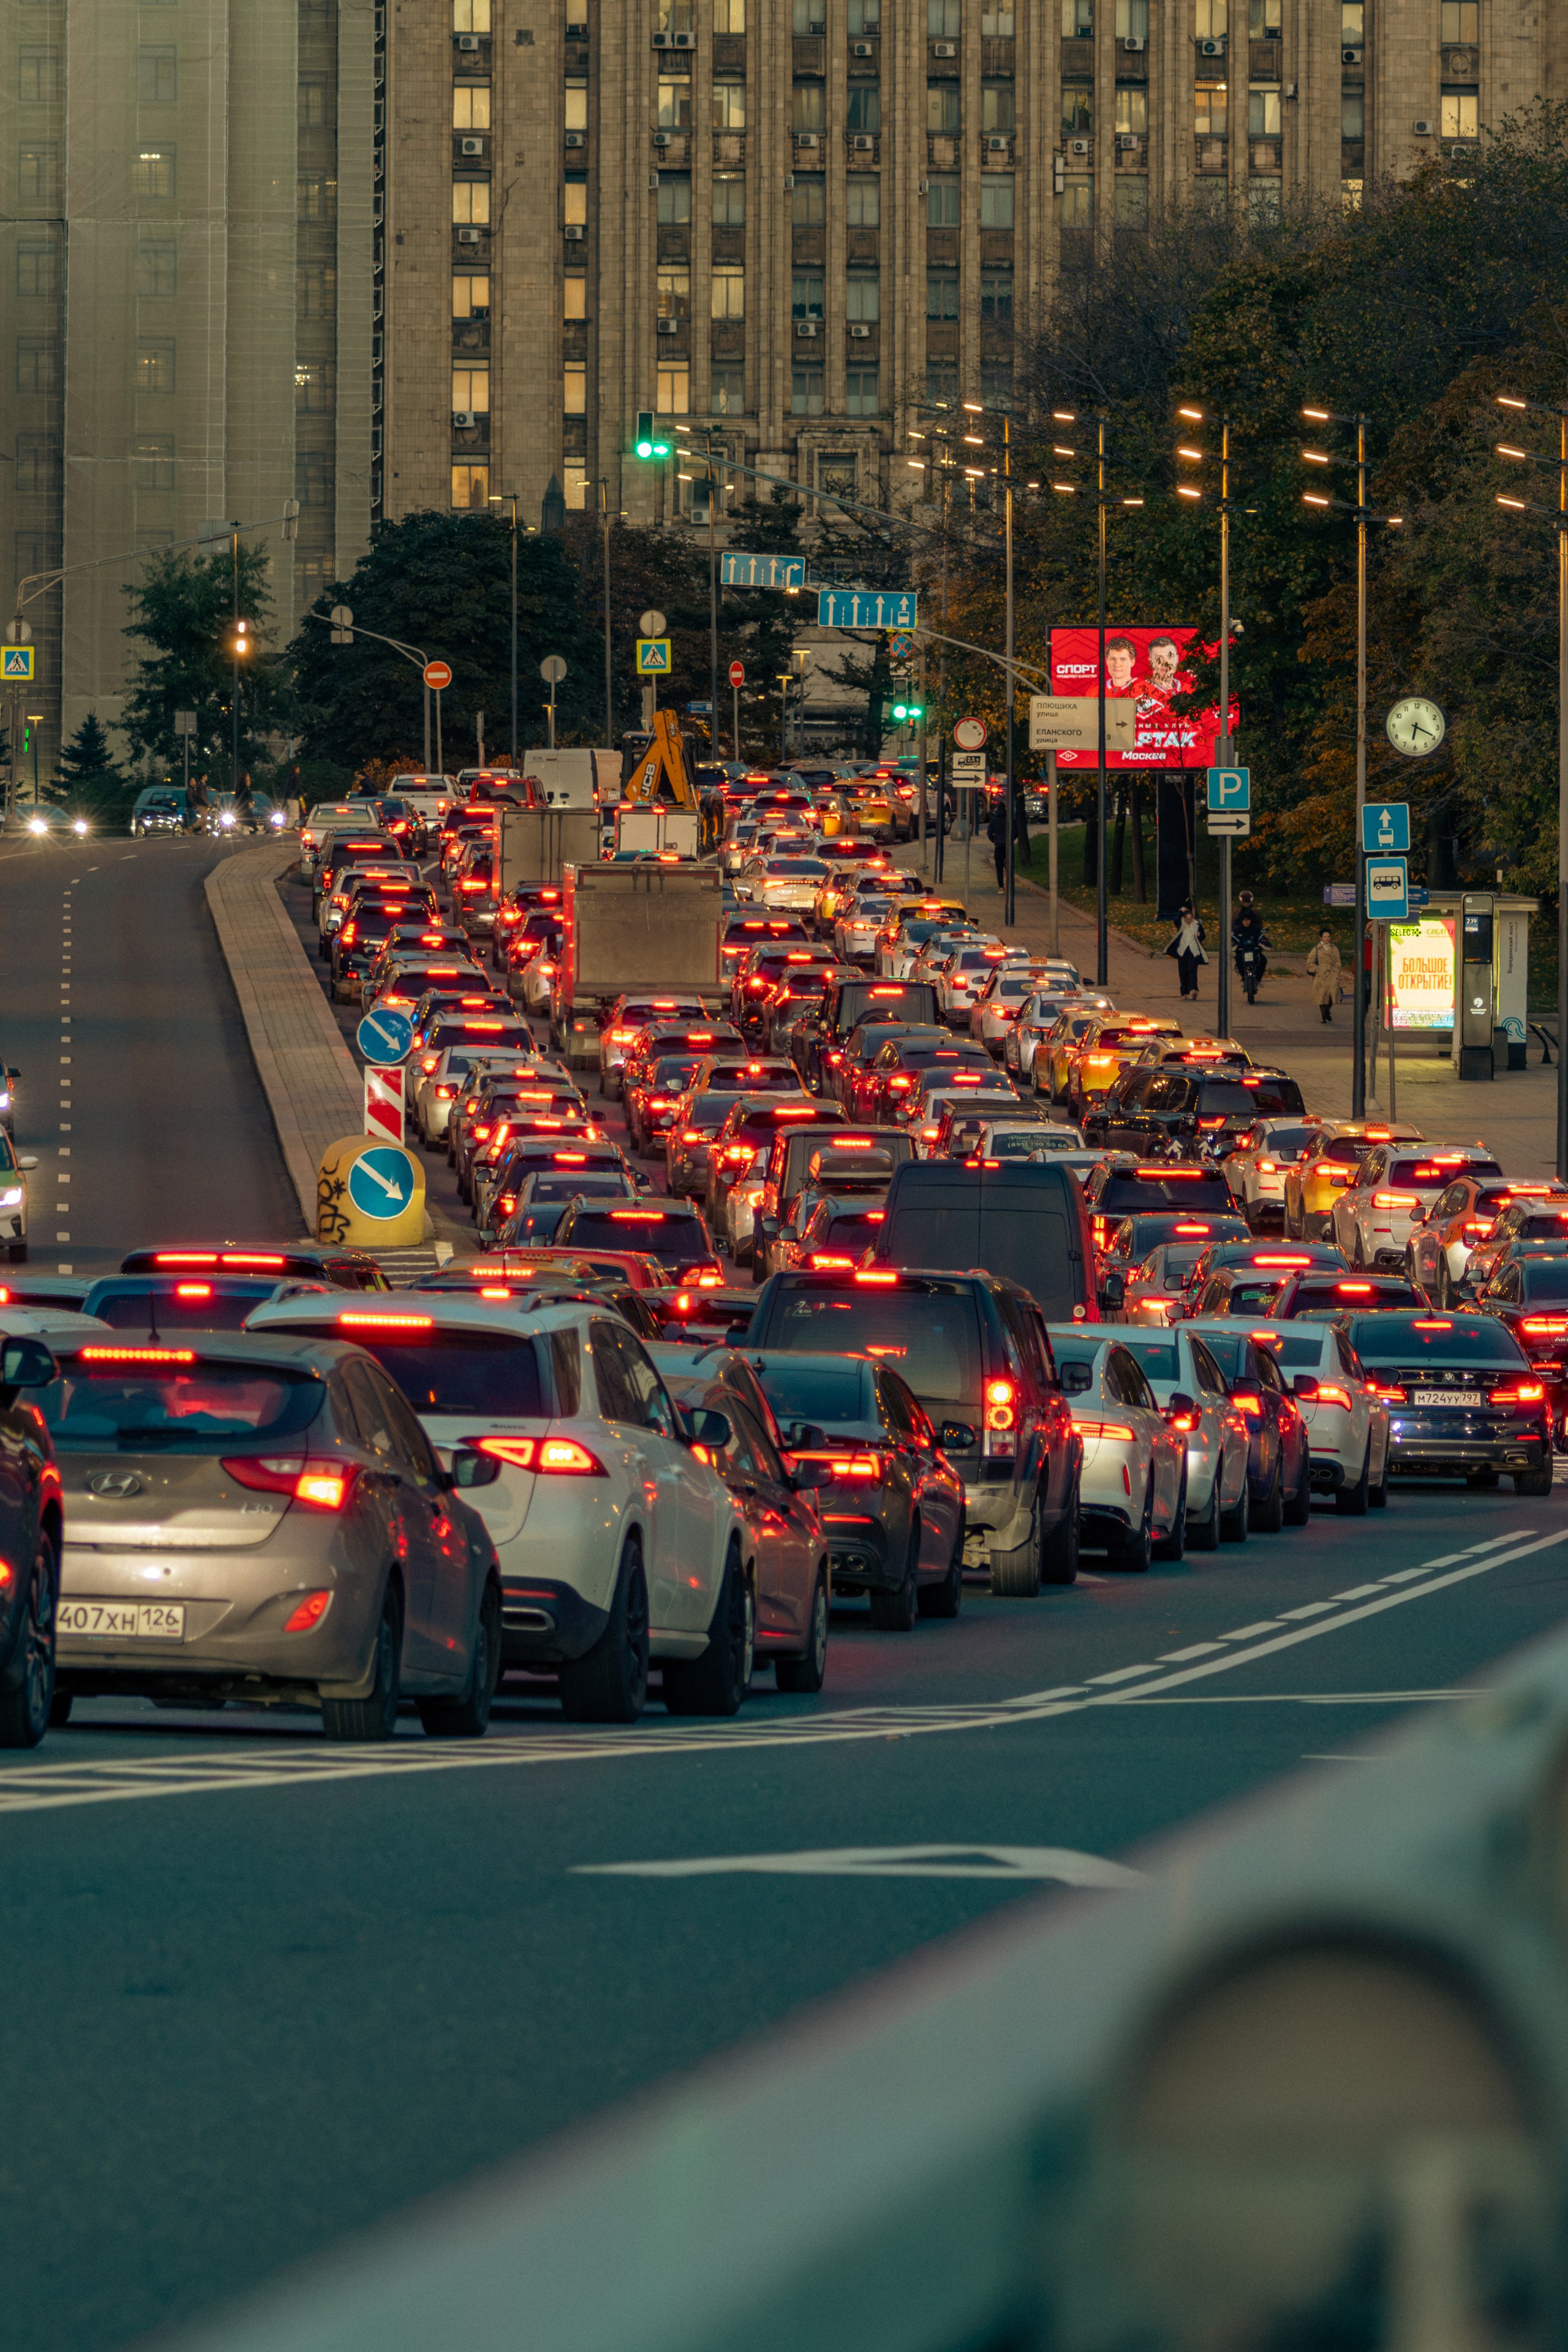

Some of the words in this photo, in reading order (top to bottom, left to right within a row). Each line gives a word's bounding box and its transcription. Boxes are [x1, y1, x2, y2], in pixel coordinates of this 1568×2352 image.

[1057, 665, 1098, 674] СПОРТ
[1135, 732, 1197, 747] РТАК
[1121, 752, 1166, 760] Москва
[642, 763, 656, 797] JCB
[1219, 772, 1242, 805] P
[1403, 958, 1448, 973] БОЛЬШОЕ
[1398, 974, 1452, 989] ОТКРЫТИЕ!
[59, 1606, 135, 1631] 407ХН
[142, 1608, 179, 1626] 126
